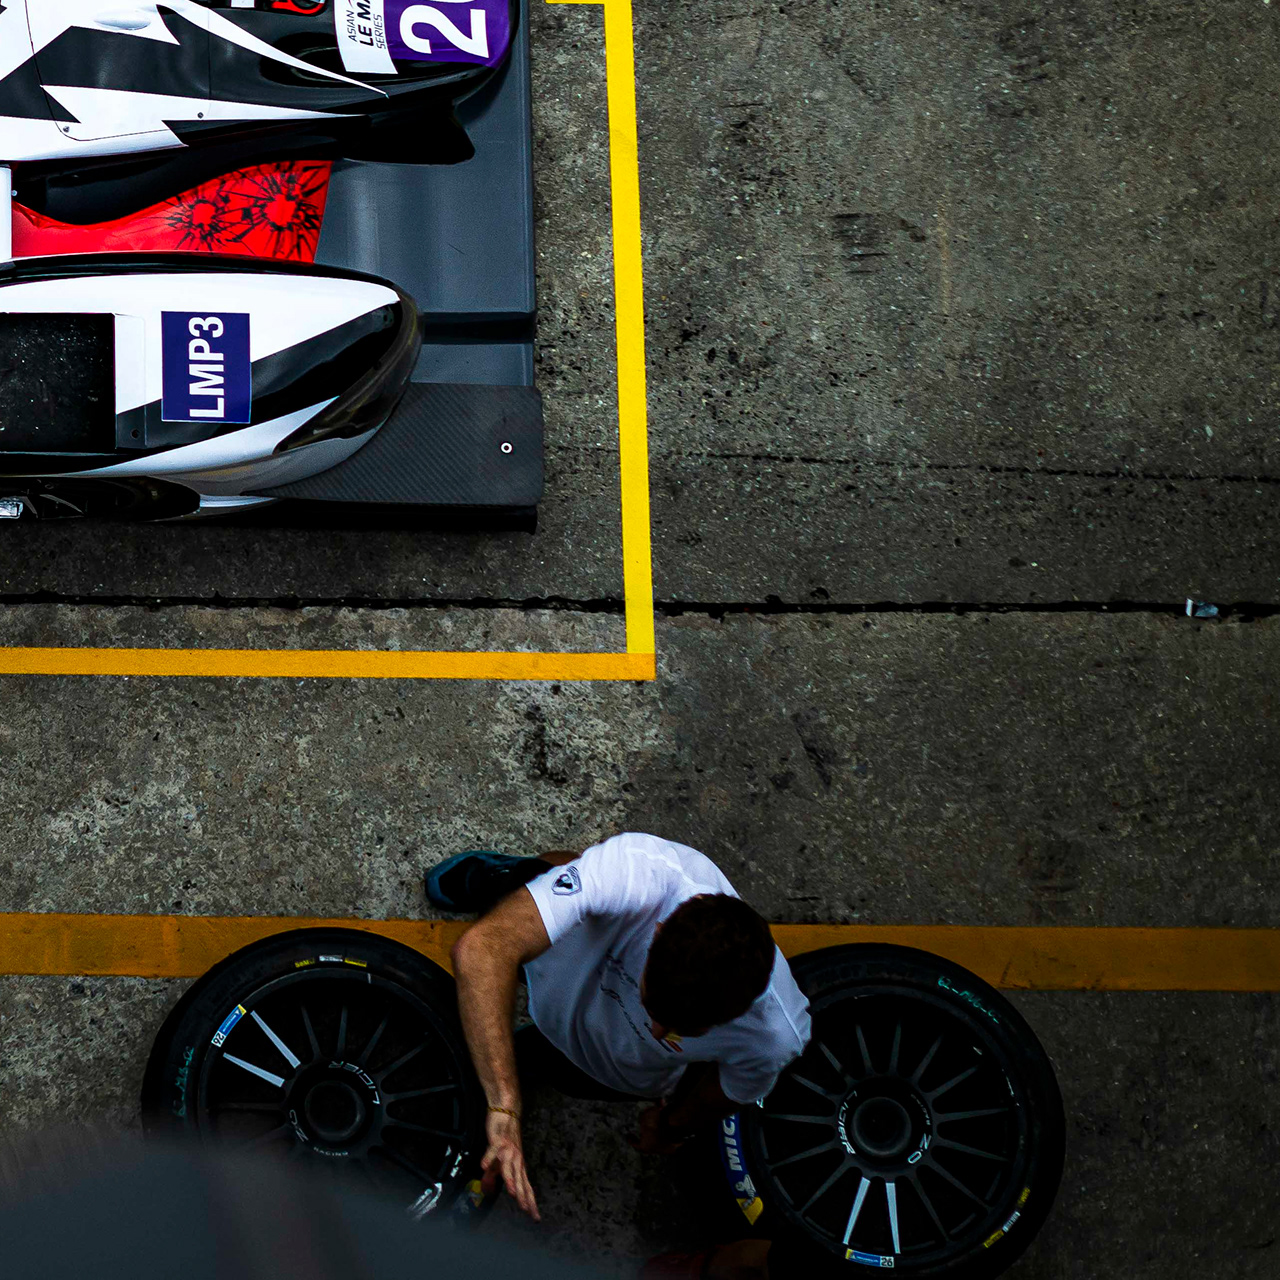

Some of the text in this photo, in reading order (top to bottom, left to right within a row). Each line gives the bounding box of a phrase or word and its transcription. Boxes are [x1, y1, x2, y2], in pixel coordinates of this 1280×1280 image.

[346, 10, 357, 42] ASIAN
[358, 25, 374, 47] LE
[373, 14, 386, 49] SERIES
[188, 316, 224, 418] LMP3
[213, 1032, 225, 1046] 26
[328, 1060, 382, 1105] LIGIER
[838, 1090, 857, 1156] LIGIER
[881, 1257, 893, 1267] 26
